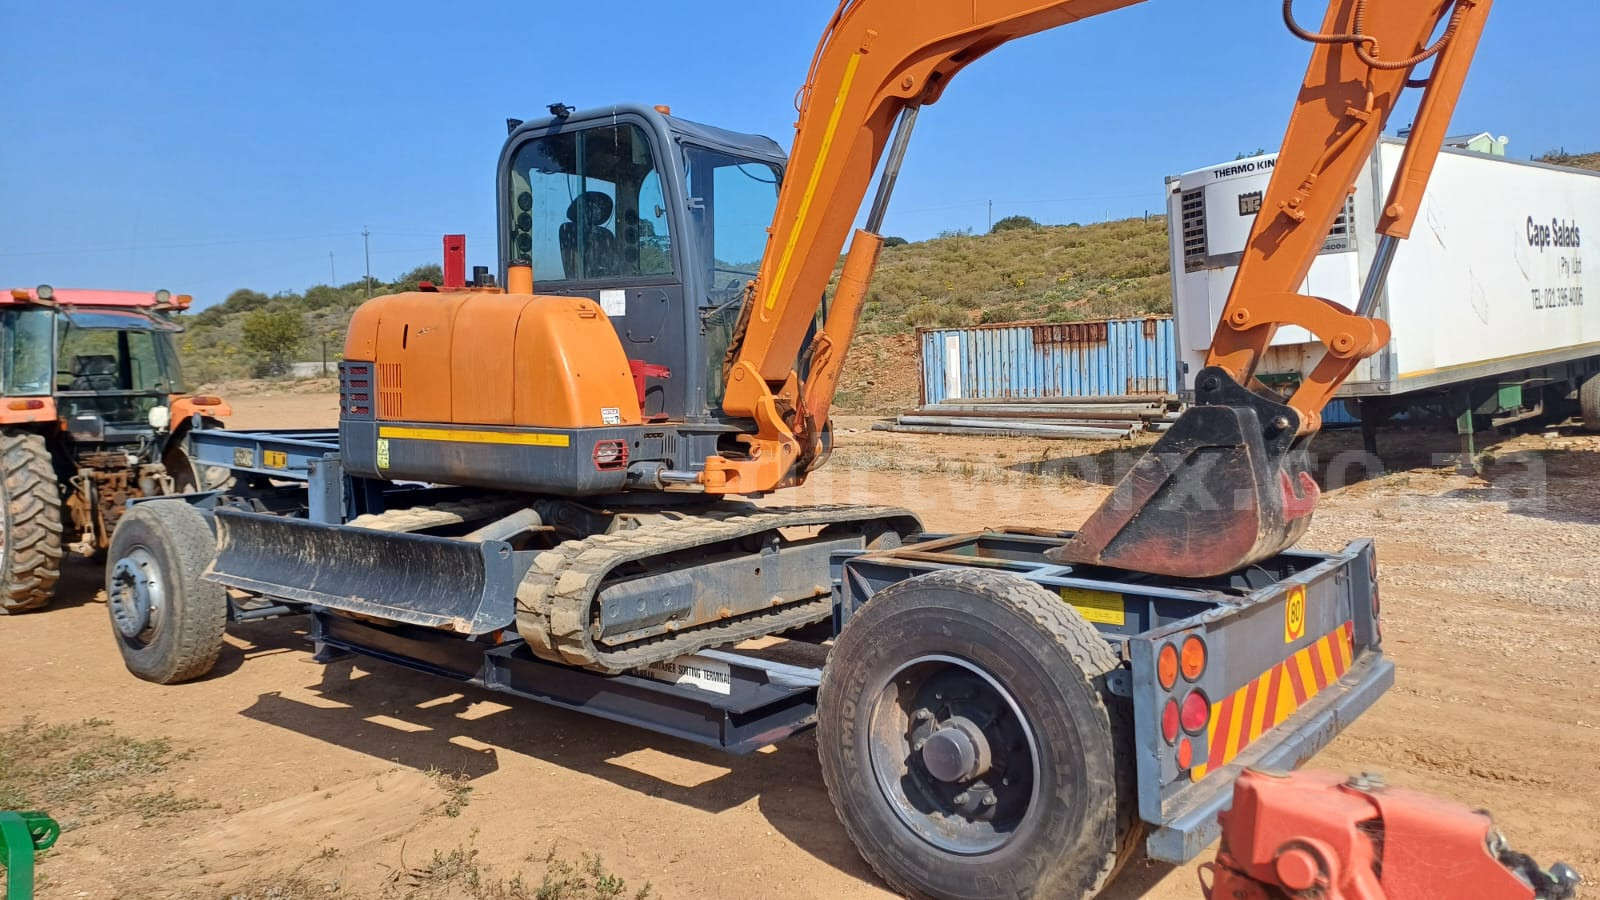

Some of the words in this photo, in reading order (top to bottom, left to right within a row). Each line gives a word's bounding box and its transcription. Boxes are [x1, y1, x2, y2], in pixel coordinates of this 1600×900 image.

[1214, 163, 1255, 179] THERMO
[1256, 158, 1279, 170] KIN
[1526, 215, 1550, 253] Cape
[1552, 217, 1580, 247] Salads
[1544, 288, 1556, 308] 021
[1291, 600, 1300, 624] 80
[679, 664, 701, 679] SORTING
[703, 669, 731, 684] TERMINAL
